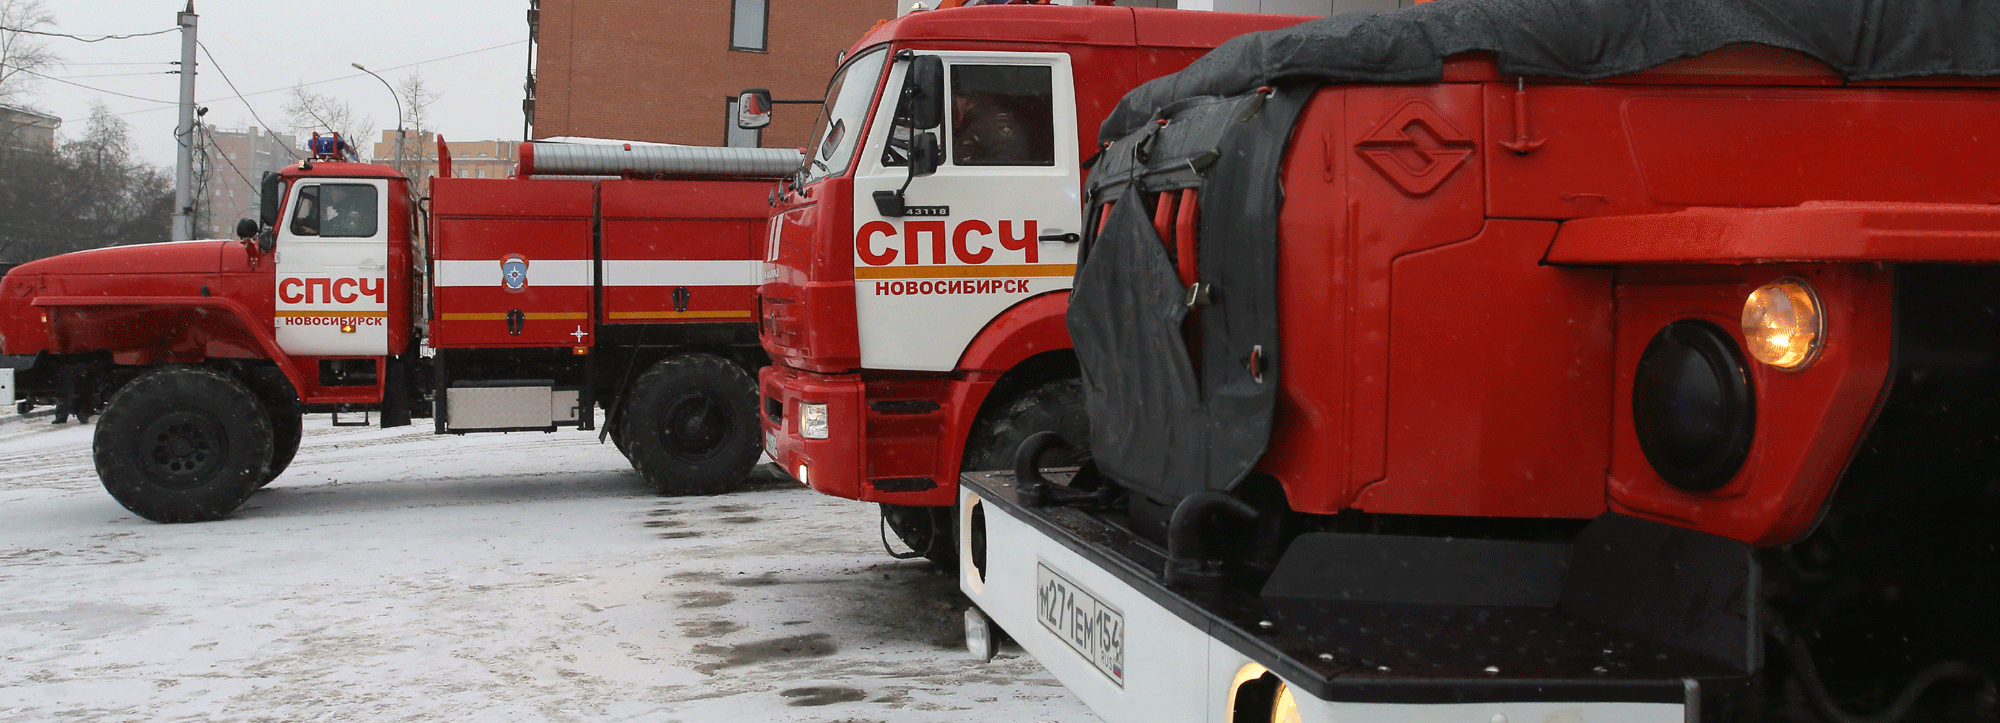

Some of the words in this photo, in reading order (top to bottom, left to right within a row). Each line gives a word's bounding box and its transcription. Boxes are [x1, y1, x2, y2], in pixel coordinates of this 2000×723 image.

[856, 219, 1039, 266] СПСЧ
[279, 277, 385, 304] СПСЧ
[875, 279, 1030, 296] НОВОСИБИРСК
[285, 317, 382, 325] НОВОСИБИРСК
[1096, 609, 1122, 661] 154
